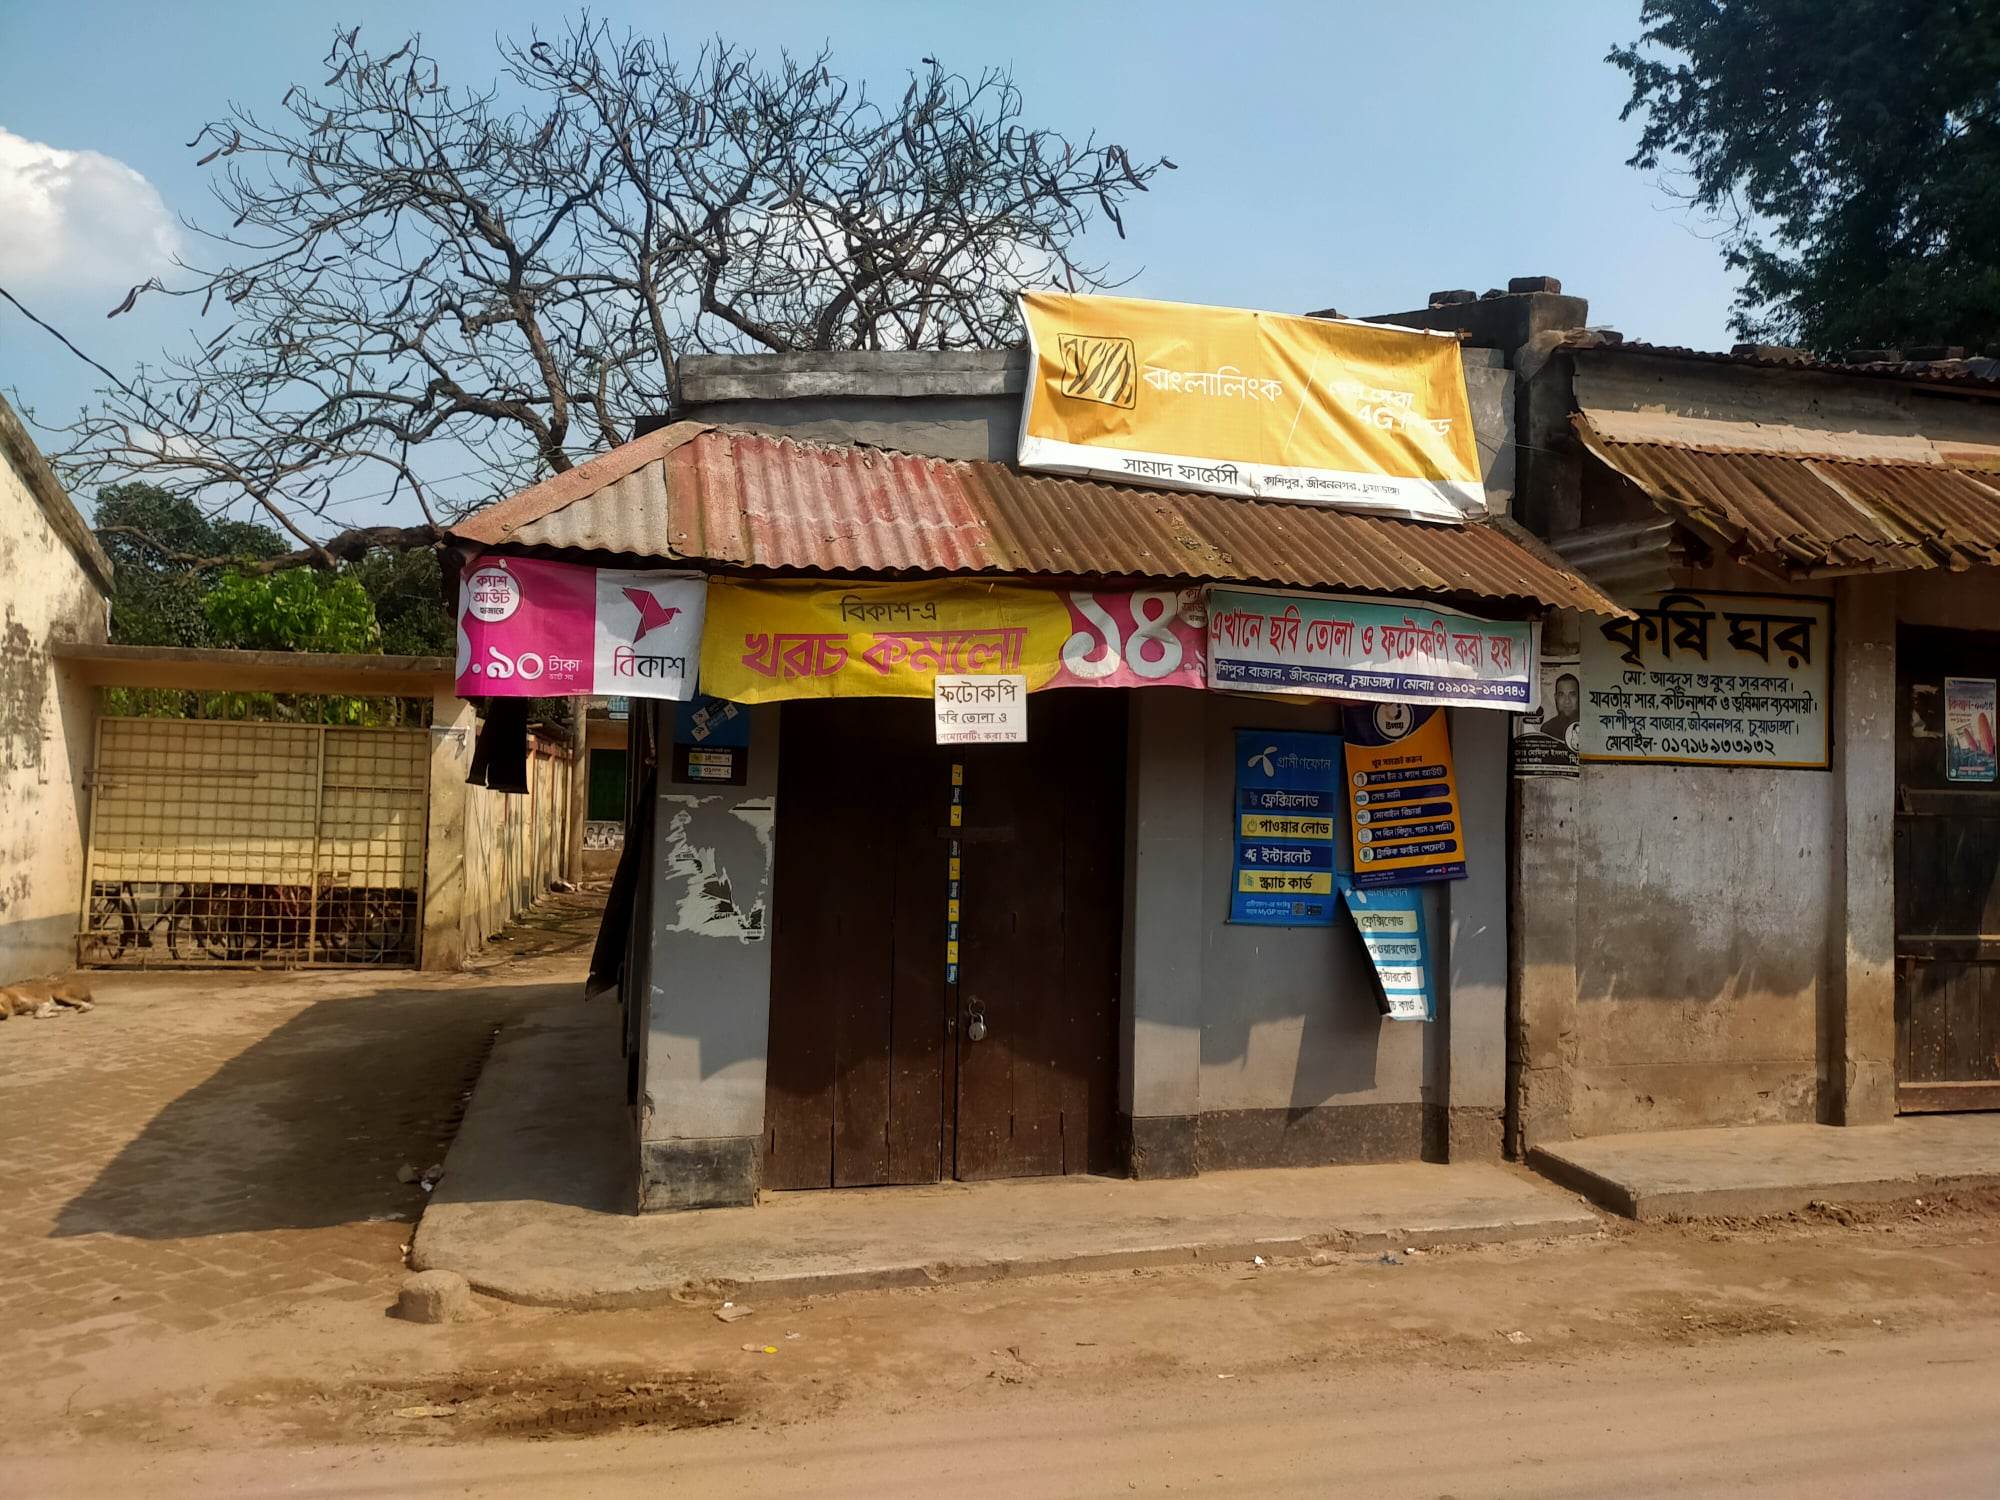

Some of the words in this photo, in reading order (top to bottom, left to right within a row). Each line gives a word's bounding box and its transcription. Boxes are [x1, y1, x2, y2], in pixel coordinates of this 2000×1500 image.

[1142, 363, 1283, 402] বাংলালিংক
[1122, 458, 1174, 479] সামাদ
[1177, 463, 1239, 486] ফার্মেসী
[476, 575, 508, 588] ক্যাশ
[473, 588, 511, 604] আউট
[480, 607, 505, 615] হাজারে
[839, 595, 938, 623] বিকাশ-এ
[1211, 608, 1265, 654] এখানে
[1269, 604, 1302, 656] ছবি
[1306, 617, 1355, 659] তোলা
[1361, 625, 1374, 656] ও
[1380, 615, 1450, 664] ফটোকপি
[1452, 631, 1484, 668] করা
[1600, 595, 1716, 669] কৃষি
[1722, 612, 1817, 669] ঘর
[614, 645, 685, 679] বিকাশ
[741, 630, 849, 679] খরচ
[858, 627, 1029, 677] কমলো
[548, 655, 580, 673] টাকা
[1216, 660, 1245, 679] শিপুর
[1248, 665, 1286, 681] বাজার,
[1289, 666, 1348, 686] জীবননগর,
[1438, 682, 1526, 699] ০১৯০২-১৭৪৭৪৬
[1696, 674, 1737, 694] শুকুর
[939, 679, 1018, 704] ফটোকপি
[1589, 685, 1633, 709] যাবতীয়
[1660, 688, 1718, 712] কীটনাশক
[1720, 696, 1730, 711] ও
[938, 710, 958, 724] ছবি
[961, 712, 995, 724] তোলা
[999, 712, 1008, 723] ও
[1599, 709, 1647, 733] কাশীপুর
[1661, 737, 1776, 756] ০১৭১৬৯৩৩৯৩২
[1279, 753, 1333, 770] গ্রামীণফোন
[1260, 790, 1320, 808] ফ্লেক্সিলোড
[1259, 819, 1299, 834] পাওয়ার
[1300, 821, 1330, 835] লোড
[1261, 846, 1312, 864] ইন্টারনেট
[1287, 873, 1313, 890] কার্ড
